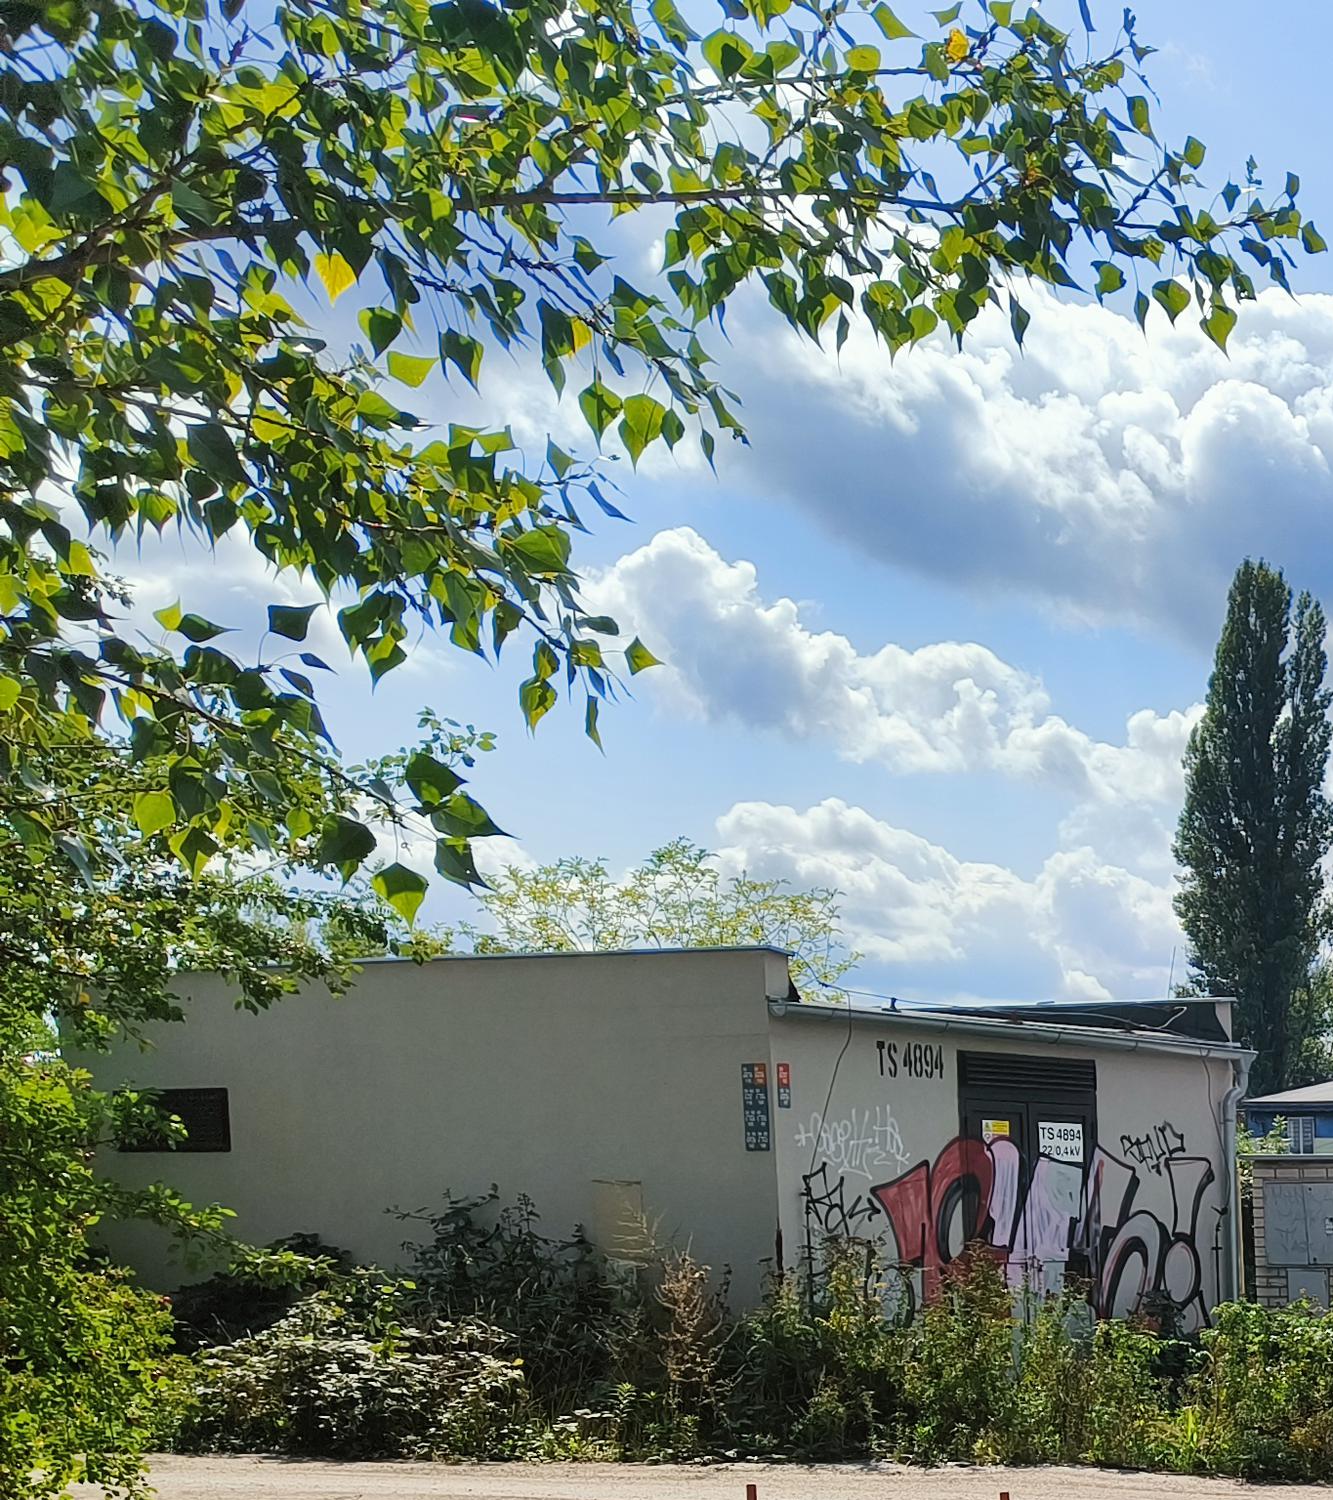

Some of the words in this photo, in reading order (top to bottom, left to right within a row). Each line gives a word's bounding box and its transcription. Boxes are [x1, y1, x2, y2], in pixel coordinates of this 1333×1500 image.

[876, 1041, 897, 1078] TS
[903, 1042, 944, 1079] 4894
[1040, 1127, 1055, 1140] TS
[1056, 1128, 1081, 1141] 4894
